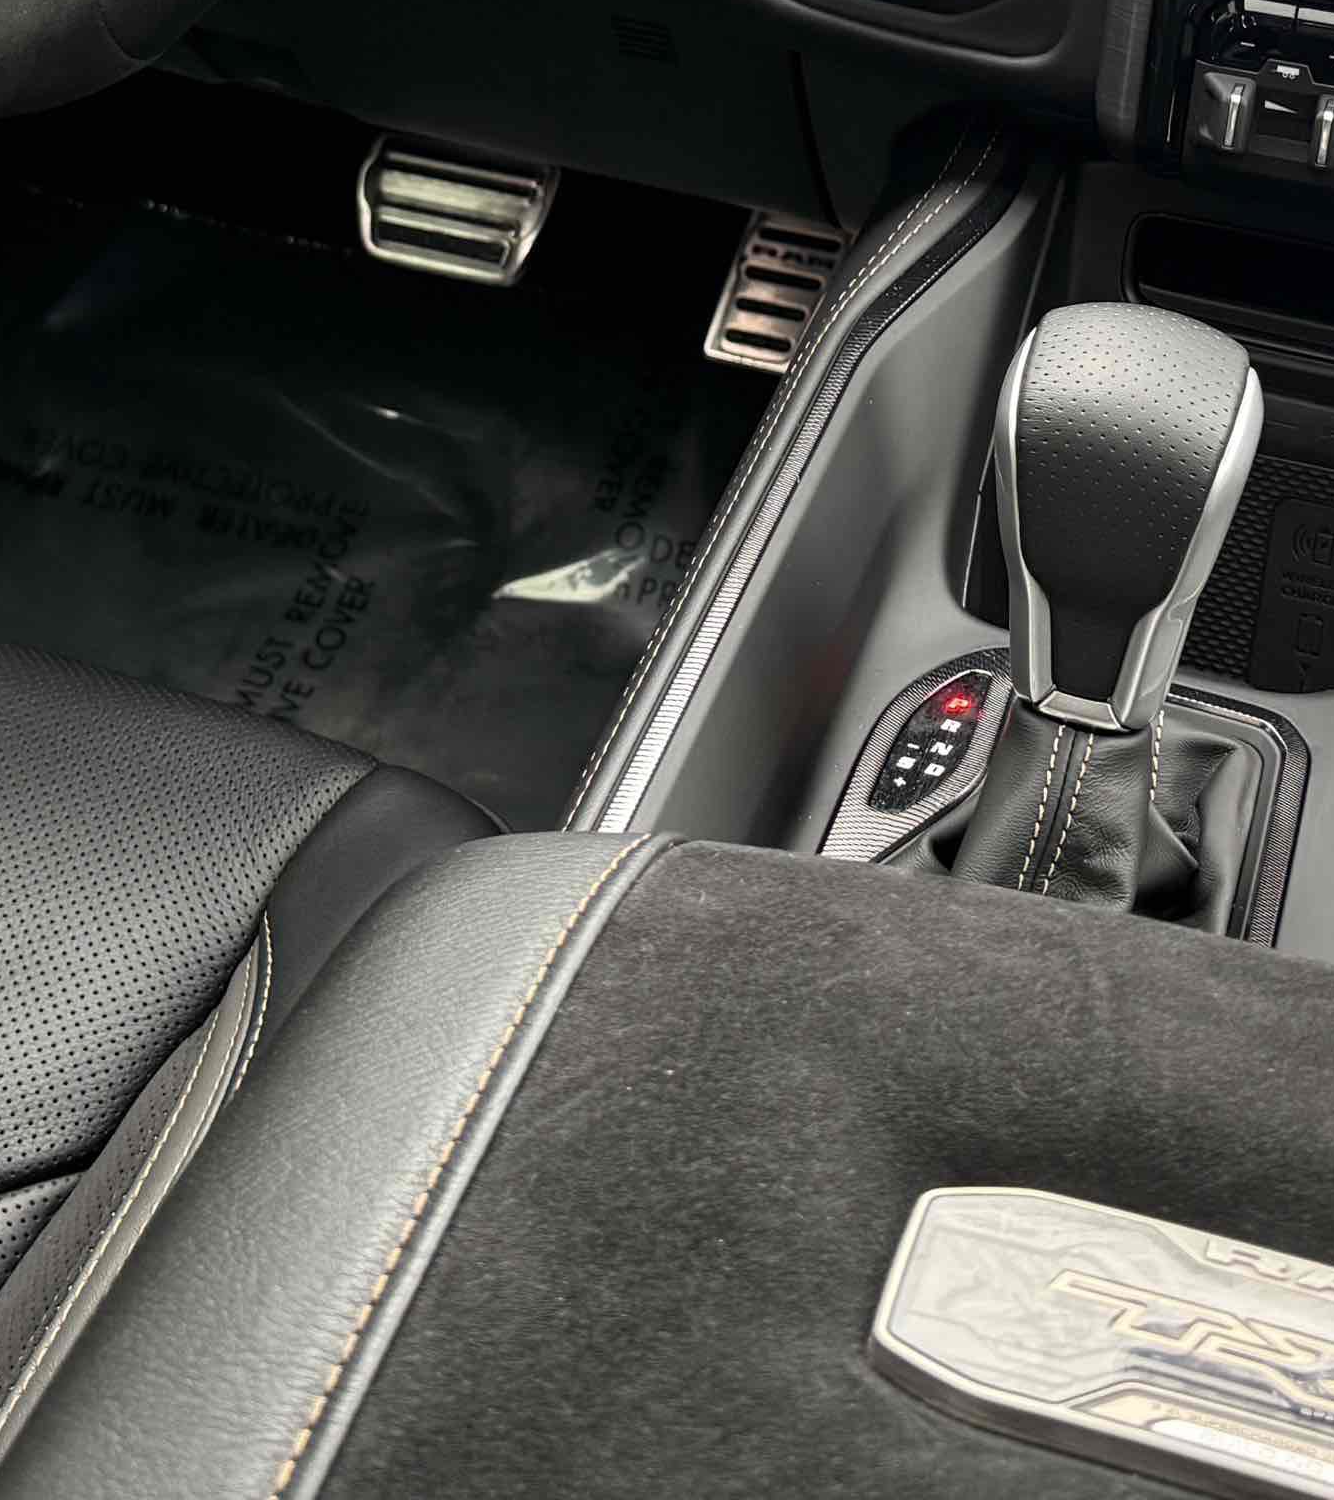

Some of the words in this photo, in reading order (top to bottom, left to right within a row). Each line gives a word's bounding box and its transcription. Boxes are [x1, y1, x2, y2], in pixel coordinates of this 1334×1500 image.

[946, 696, 970, 713] P
[940, 718, 962, 733] R
[930, 741, 954, 756] N
